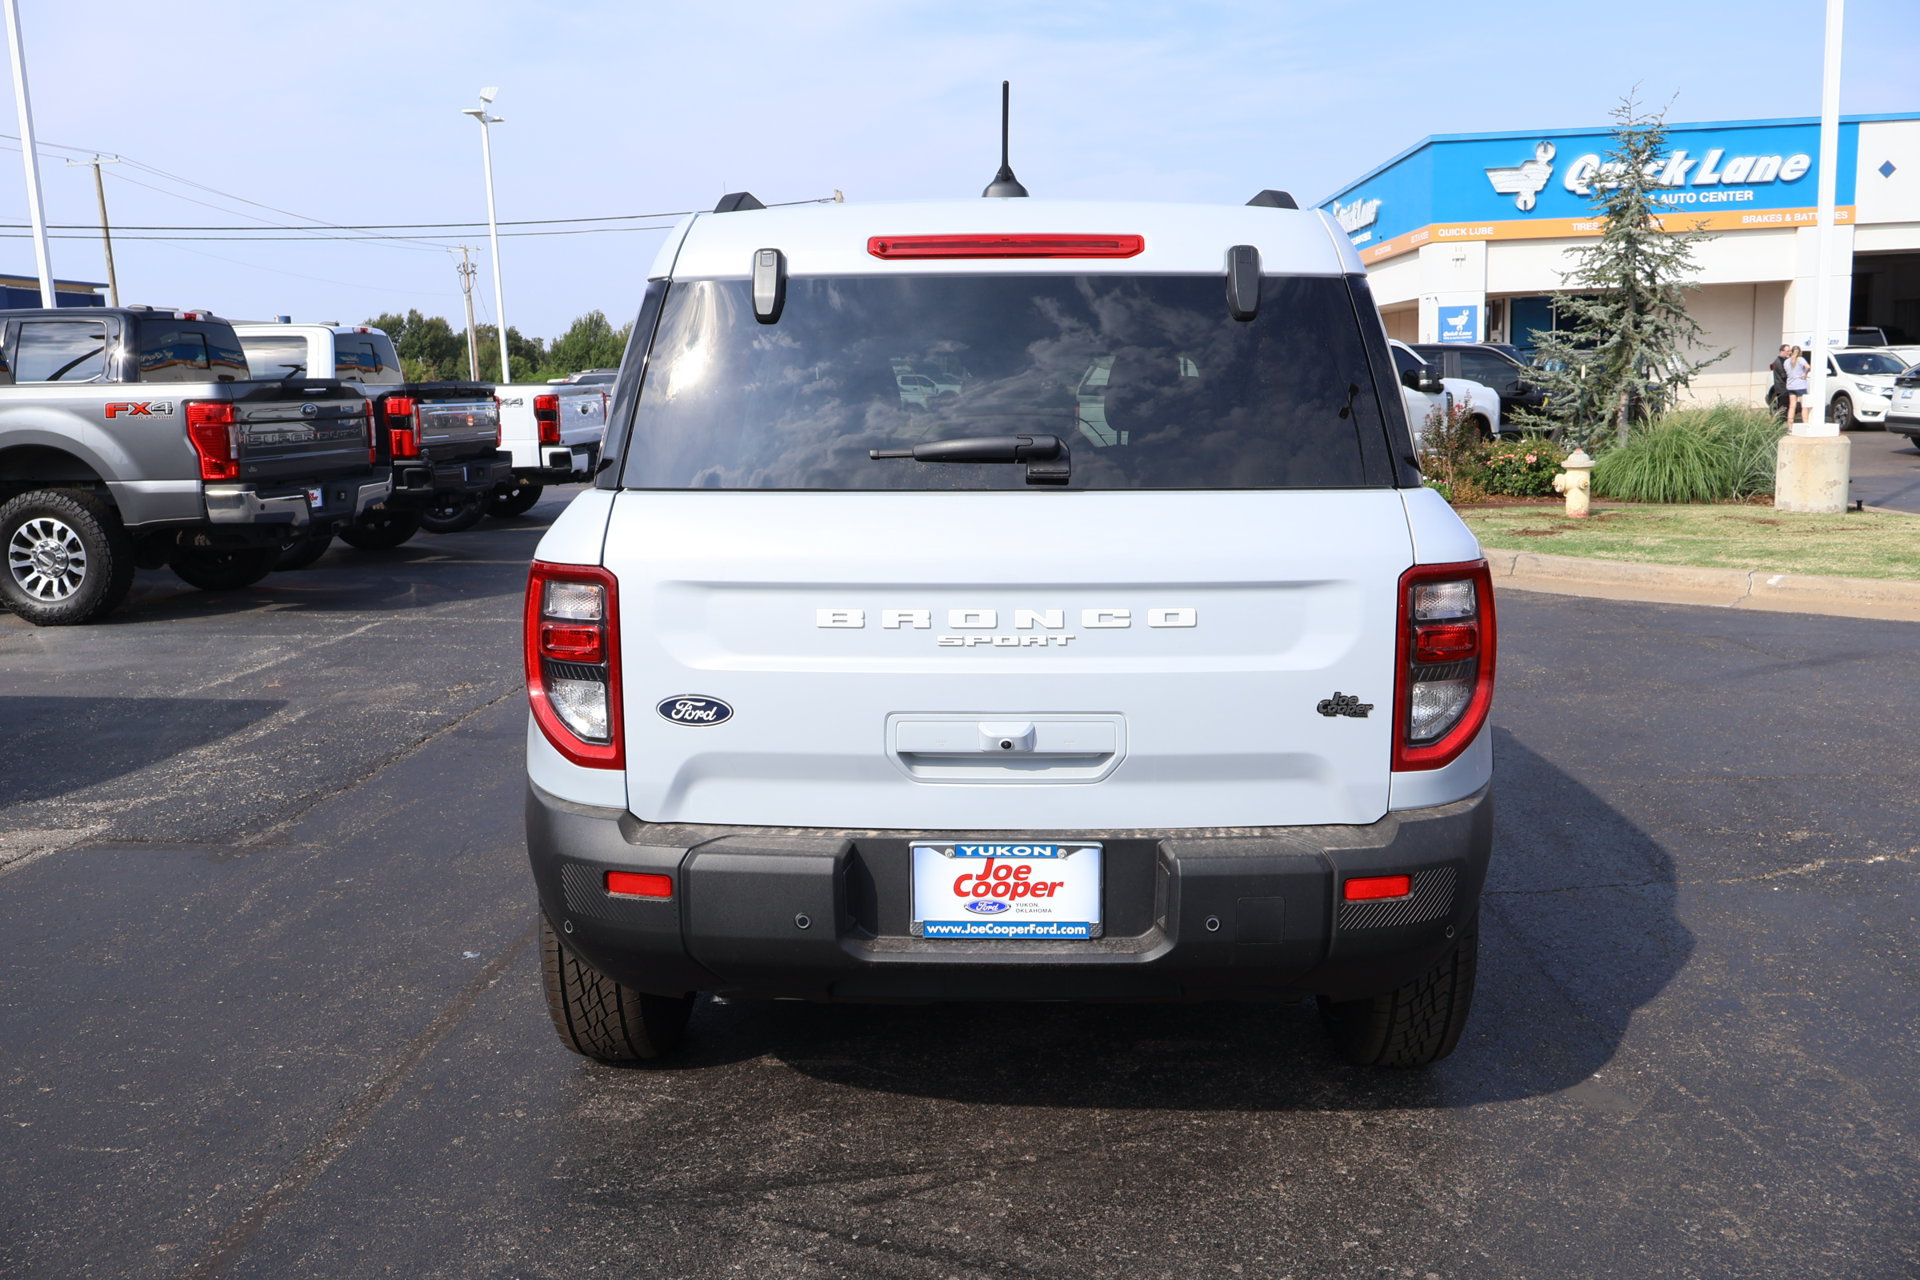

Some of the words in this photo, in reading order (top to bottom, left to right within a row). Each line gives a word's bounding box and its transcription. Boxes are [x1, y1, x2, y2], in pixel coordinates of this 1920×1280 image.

[1692, 148, 1811, 185] Lane
[1660, 193, 1697, 204] AUTO
[1700, 190, 1754, 203] CENTER
[1742, 213, 1782, 224] BRAKES
[1784, 213, 1792, 222] &
[1795, 211, 1849, 222] BATTES
[1438, 227, 1467, 237] QUICK
[1469, 226, 1494, 236] LUBE
[1572, 222, 1599, 231] TIRES
[105, 401, 174, 419] FX4
[248, 432, 315, 446] SUPER
[816, 607, 1198, 629] BRONCO
[937, 634, 1076, 647] SPORT
[1330, 691, 1359, 705] Joe
[671, 700, 718, 721] Ford
[1317, 699, 1374, 717] Cooper
[961, 846, 1052, 856] YUKON
[975, 857, 1032, 881] Joe
[953, 874, 1064, 901] Cooper
[975, 901, 1000, 912] Ford
[927, 923, 1086, 937] www.JoeCooperFord.com
